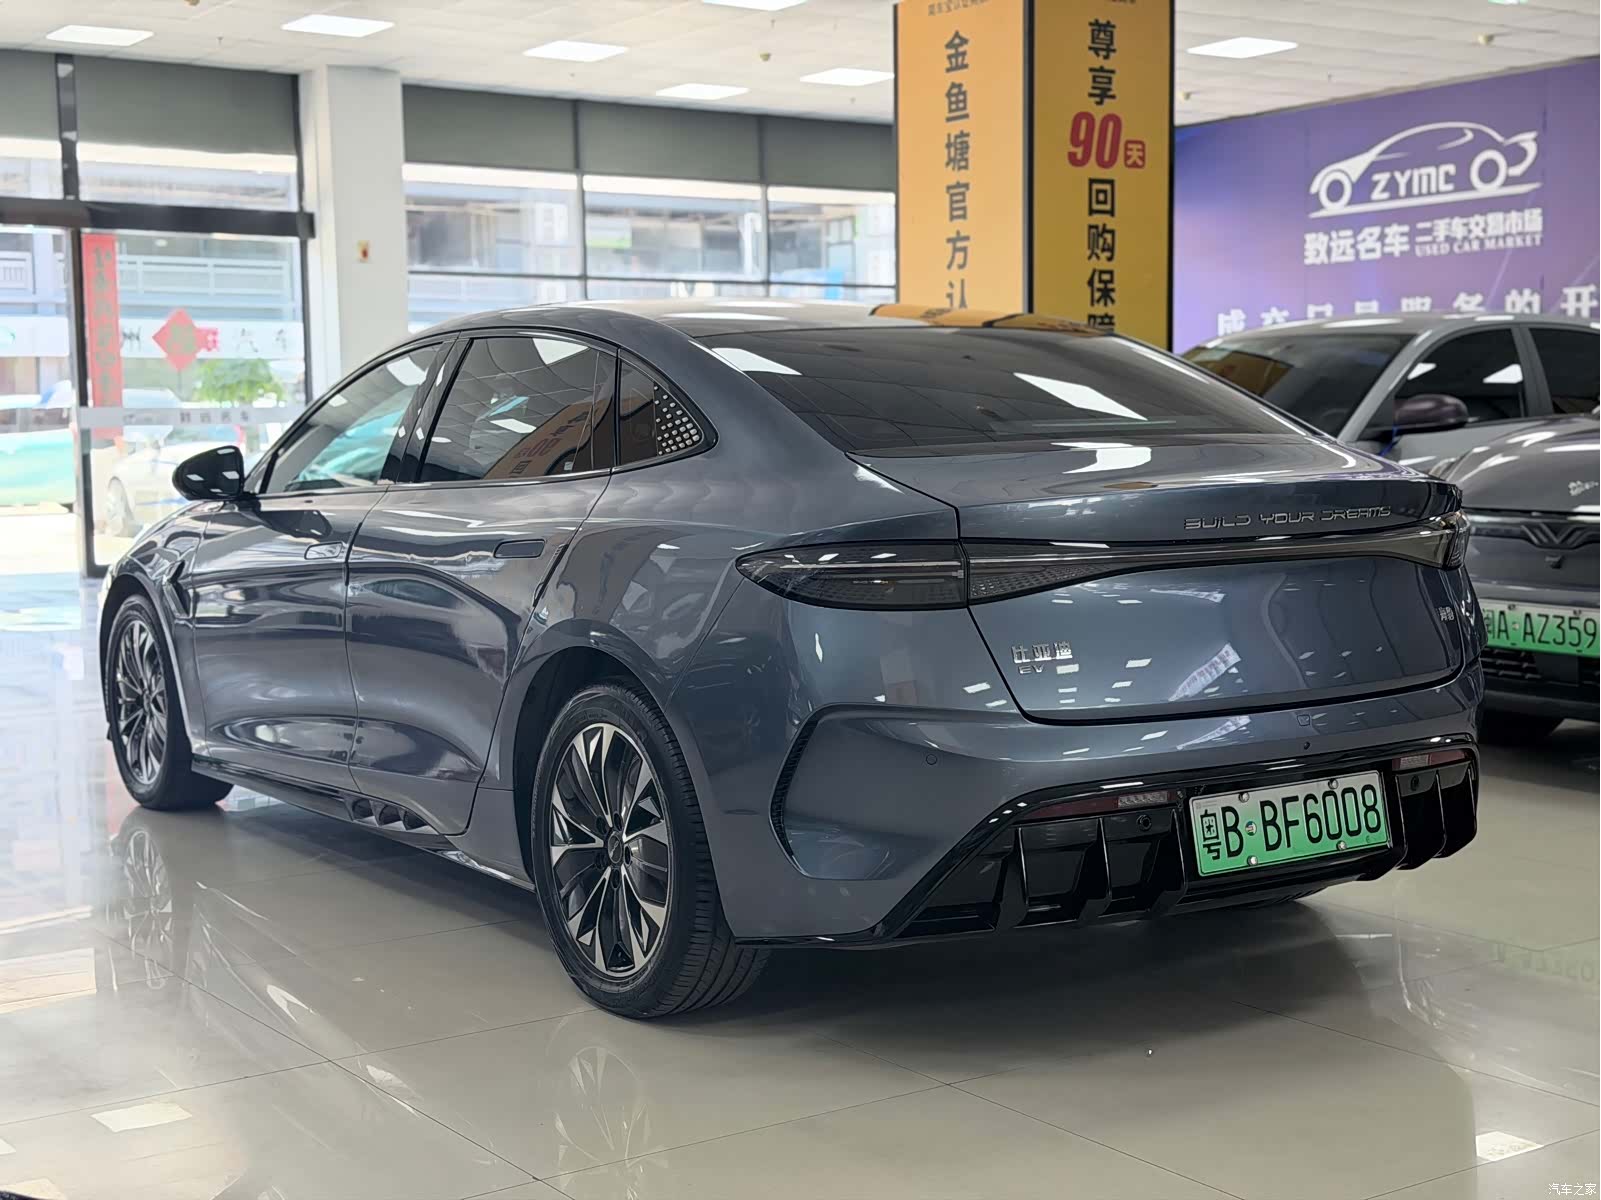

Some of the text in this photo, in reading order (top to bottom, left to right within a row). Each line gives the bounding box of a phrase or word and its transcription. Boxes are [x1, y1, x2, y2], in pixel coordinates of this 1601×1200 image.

[1372, 164, 1456, 200] ZYMC
[1304, 207, 1543, 265] 致远名车 二手车交易市场
[1416, 233, 1543, 258] USED CAR MARKET
[1184, 506, 1391, 530] BUILD YOUR DREAMS
[1018, 664, 1045, 675] EV
